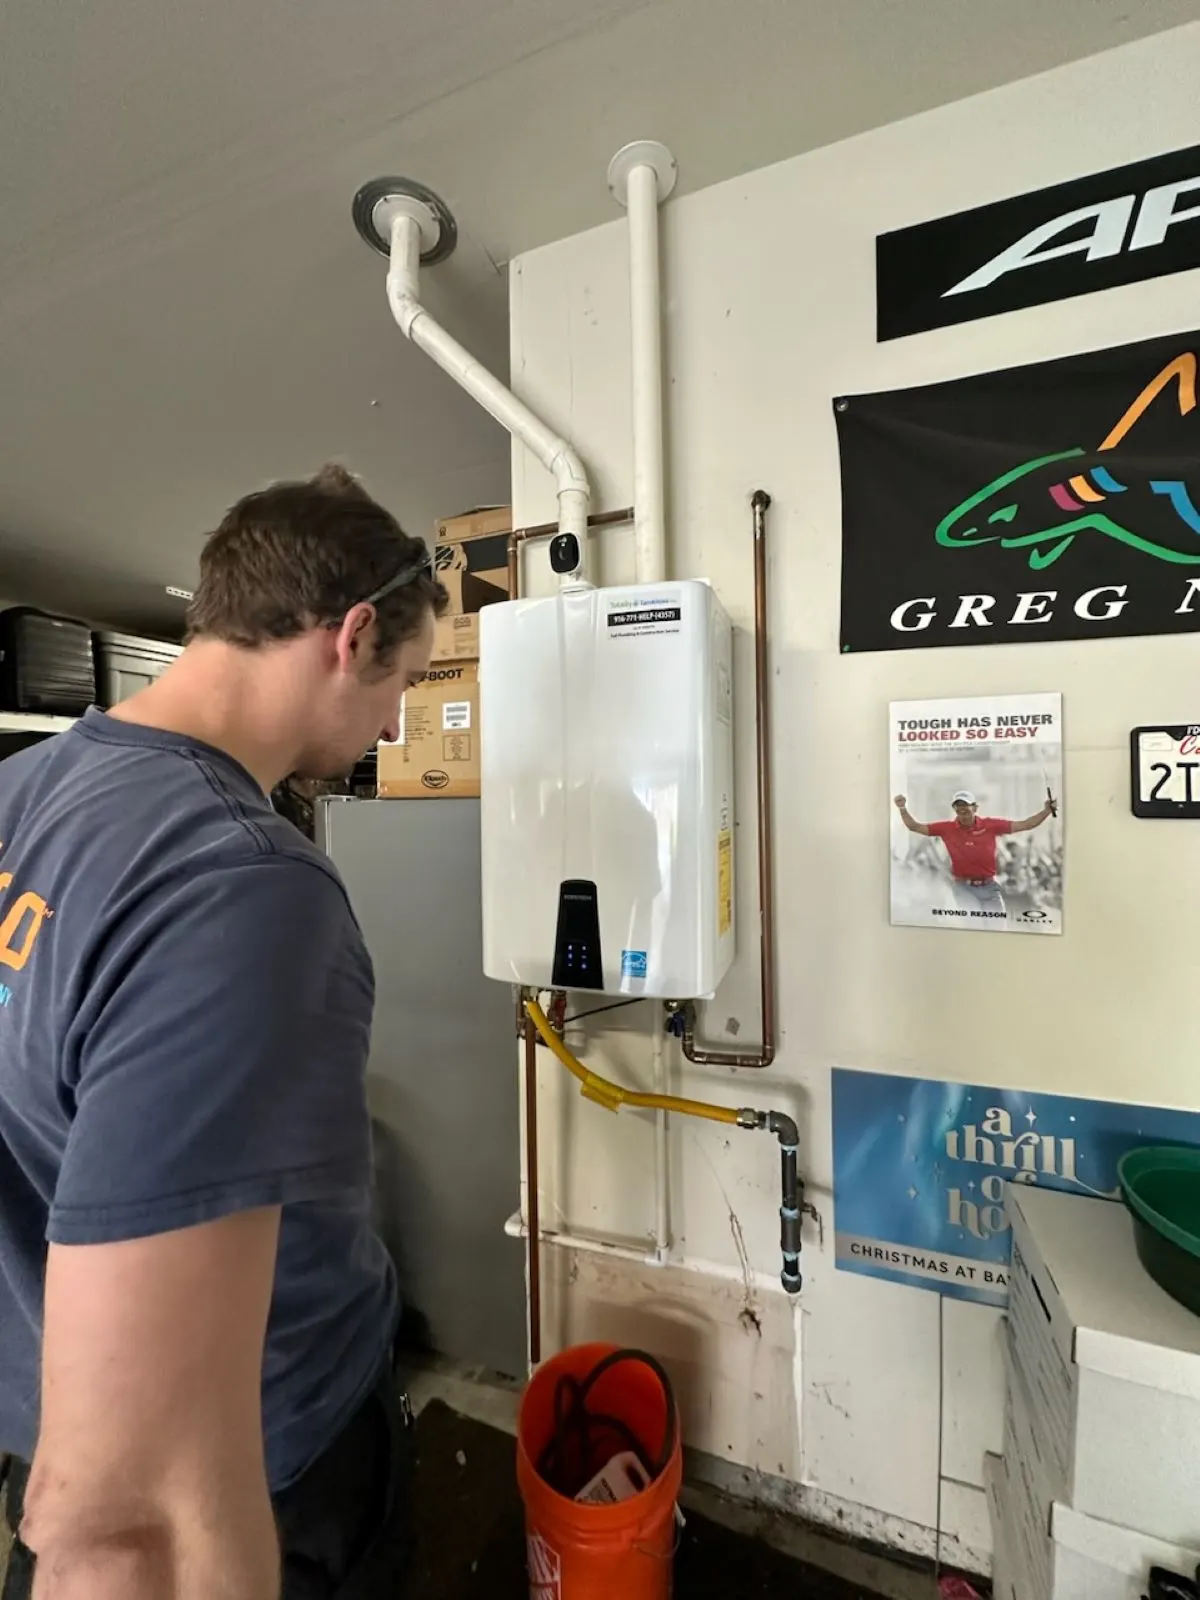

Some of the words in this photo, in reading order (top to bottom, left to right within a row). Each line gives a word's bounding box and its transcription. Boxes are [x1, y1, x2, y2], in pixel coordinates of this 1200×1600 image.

[890, 585, 1129, 632] GREG
[898, 719, 952, 731] TOUGH
[957, 716, 991, 728] HAS
[997, 714, 1053, 726] NEVER
[898, 729, 960, 742] LOOKED
[966, 729, 988, 740] SO
[994, 727, 1039, 739] EASY
[1150, 762, 1200, 802] 2T
[932, 909, 967, 917] BEYOND
[970, 911, 1007, 919] REASON
[982, 1107, 1013, 1137] a
[945, 1124, 1098, 1187] thrill
[947, 1188, 1010, 1240] ho
[851, 1242, 949, 1274] CHRISTMAS
[955, 1265, 977, 1280] AT
[984, 1270, 1012, 1287] BA
